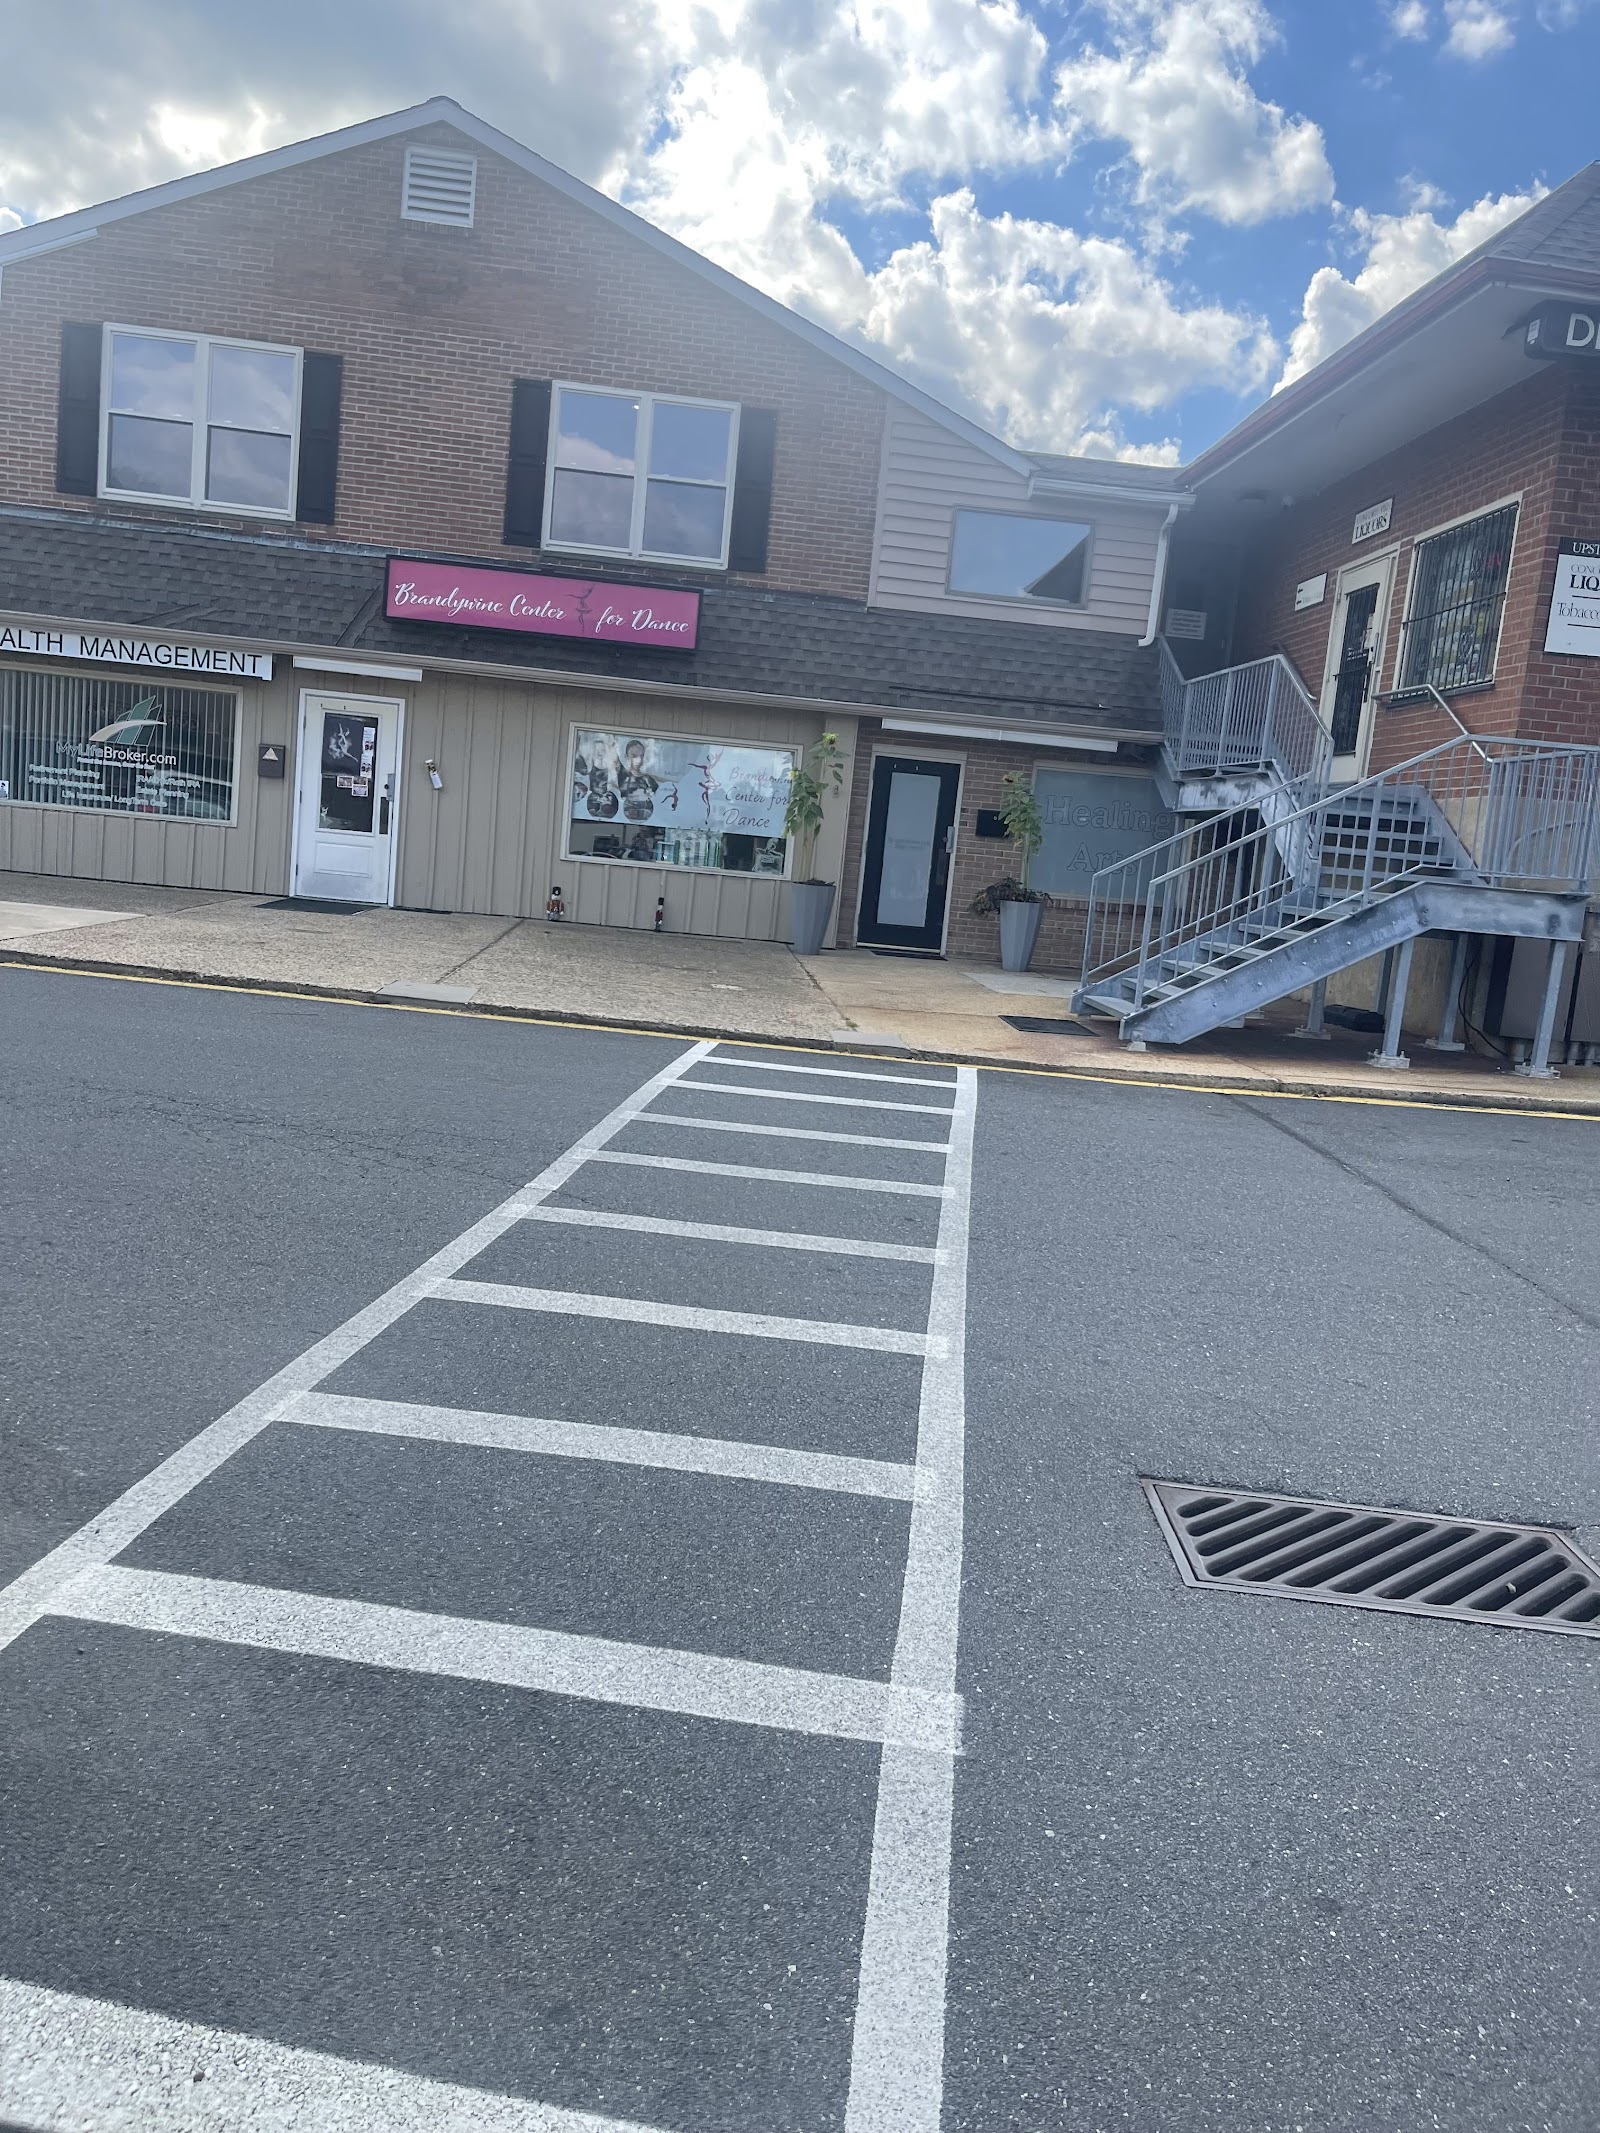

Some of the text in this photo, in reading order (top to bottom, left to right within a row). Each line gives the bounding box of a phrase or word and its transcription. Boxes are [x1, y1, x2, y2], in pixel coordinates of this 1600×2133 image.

[394, 582, 690, 633] Brandywine Center for Dance
[0, 627, 263, 674] ALTH MANAGEMENT
[722, 808, 771, 828] Dance
[725, 786, 791, 811] Center for
[1043, 795, 1174, 840] Healing
[1066, 842, 1138, 876] Arts
